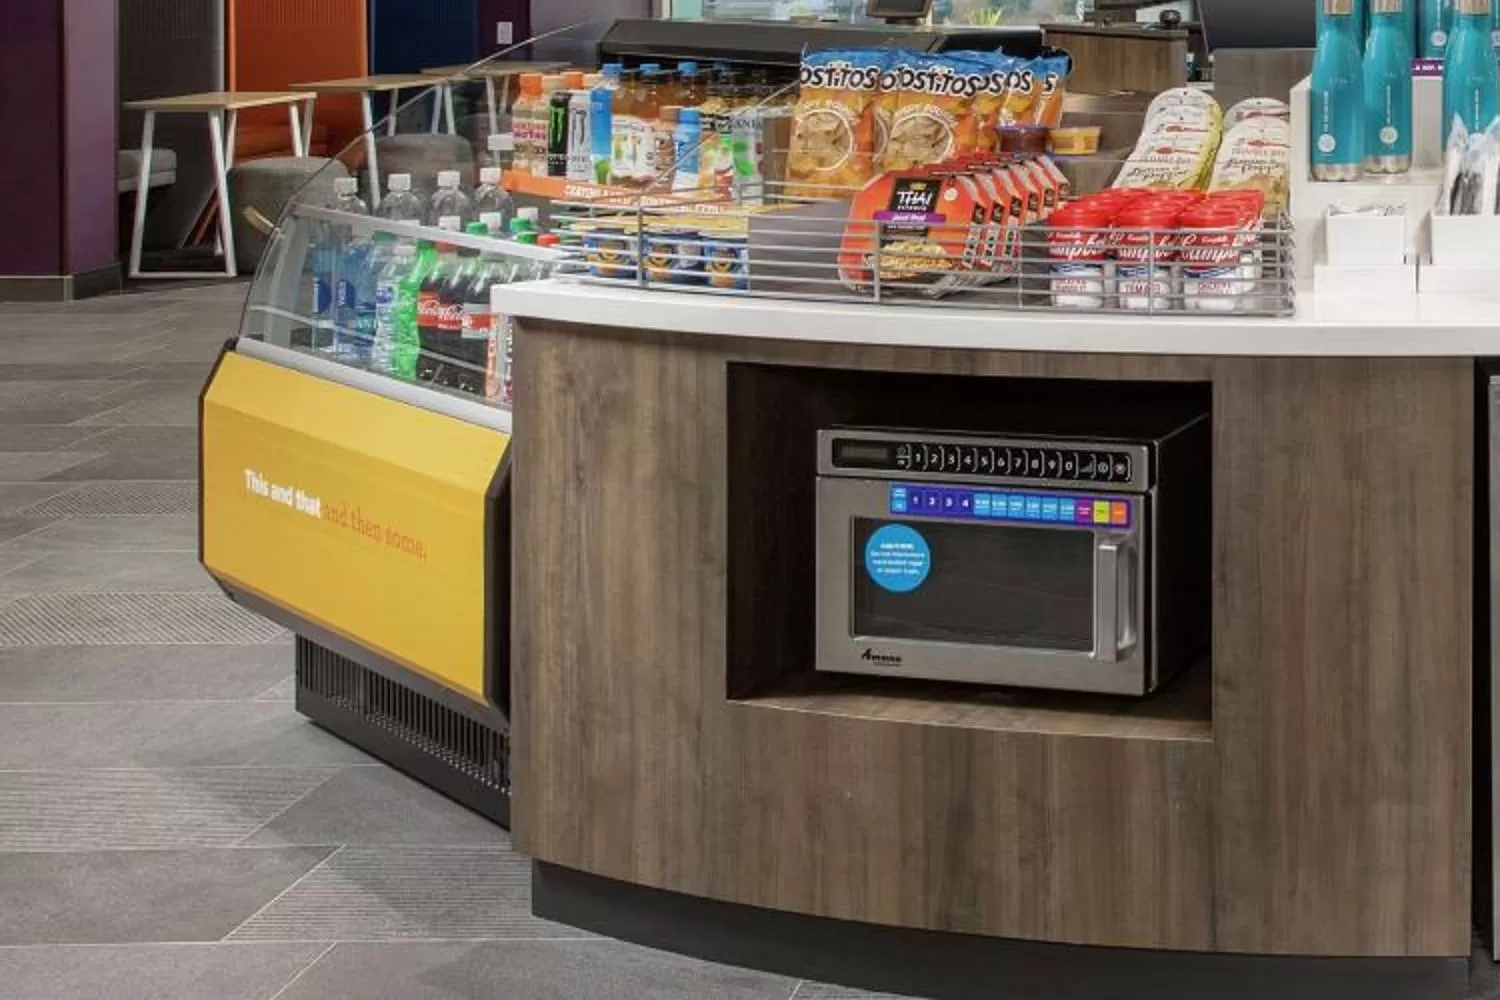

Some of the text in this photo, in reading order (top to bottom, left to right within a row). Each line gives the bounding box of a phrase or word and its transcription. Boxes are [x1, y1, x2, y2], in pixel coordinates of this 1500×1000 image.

[896, 191, 932, 205] THAI
[244, 468, 269, 497] This
[271, 483, 293, 508] and
[351, 505, 380, 543] then
